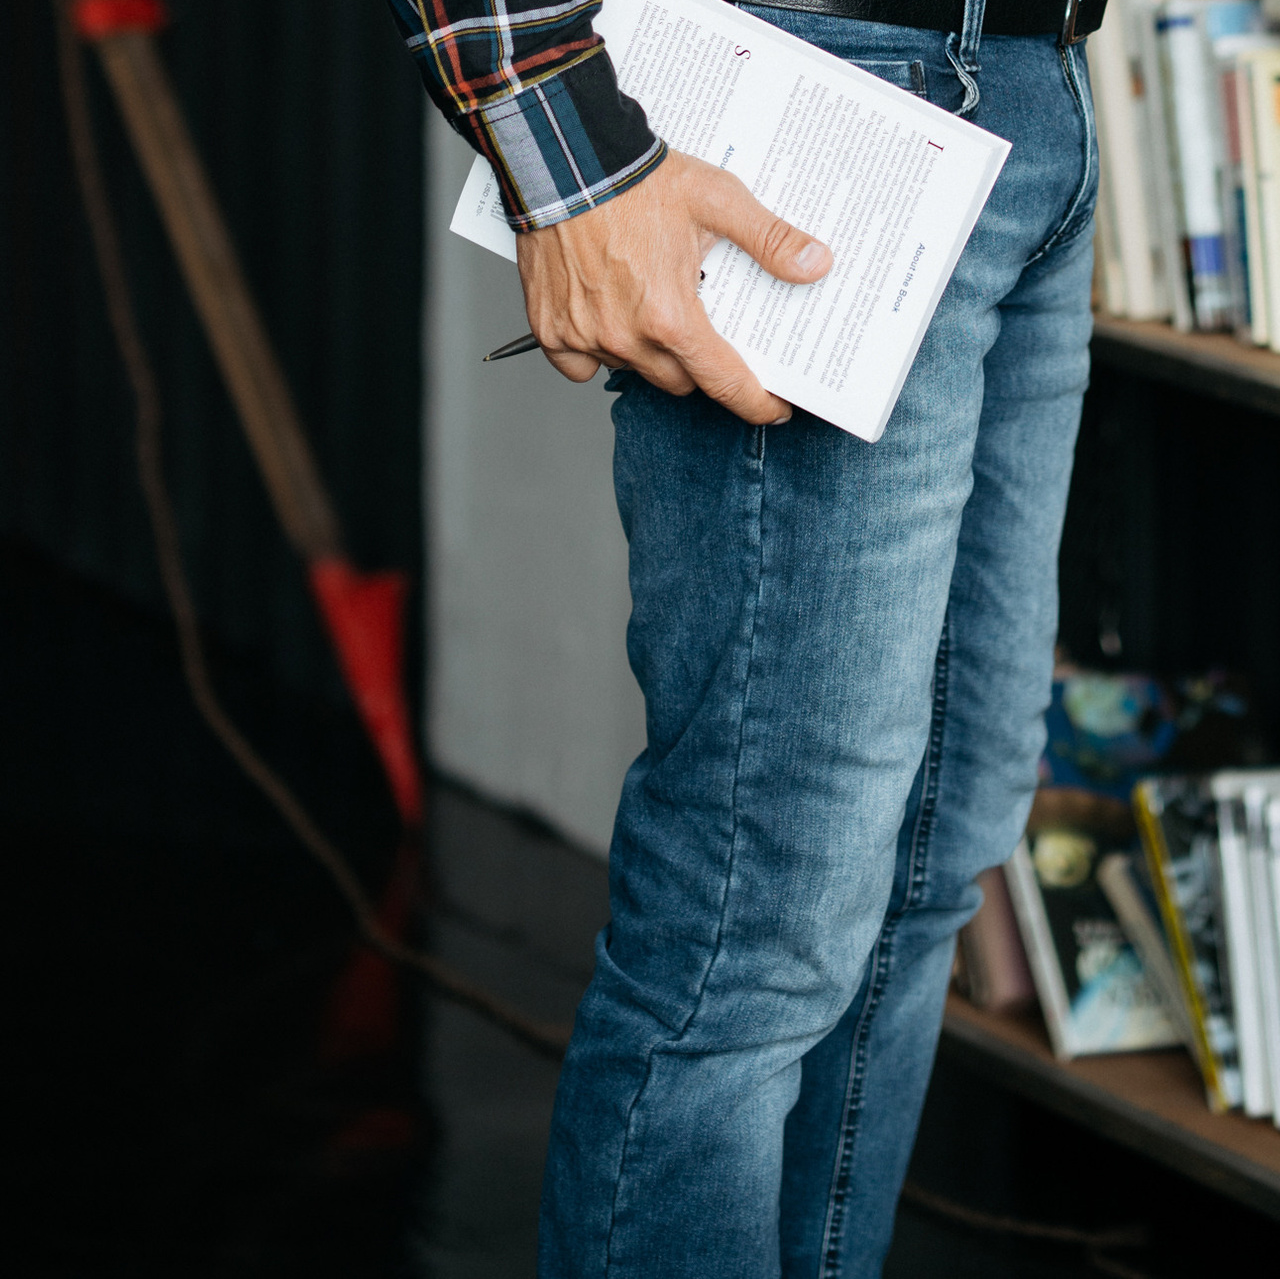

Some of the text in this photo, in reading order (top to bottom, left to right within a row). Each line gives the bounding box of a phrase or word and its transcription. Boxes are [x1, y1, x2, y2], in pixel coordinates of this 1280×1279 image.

[719, 144, 735, 170] Abou
[891, 242, 926, 314] About the Book
